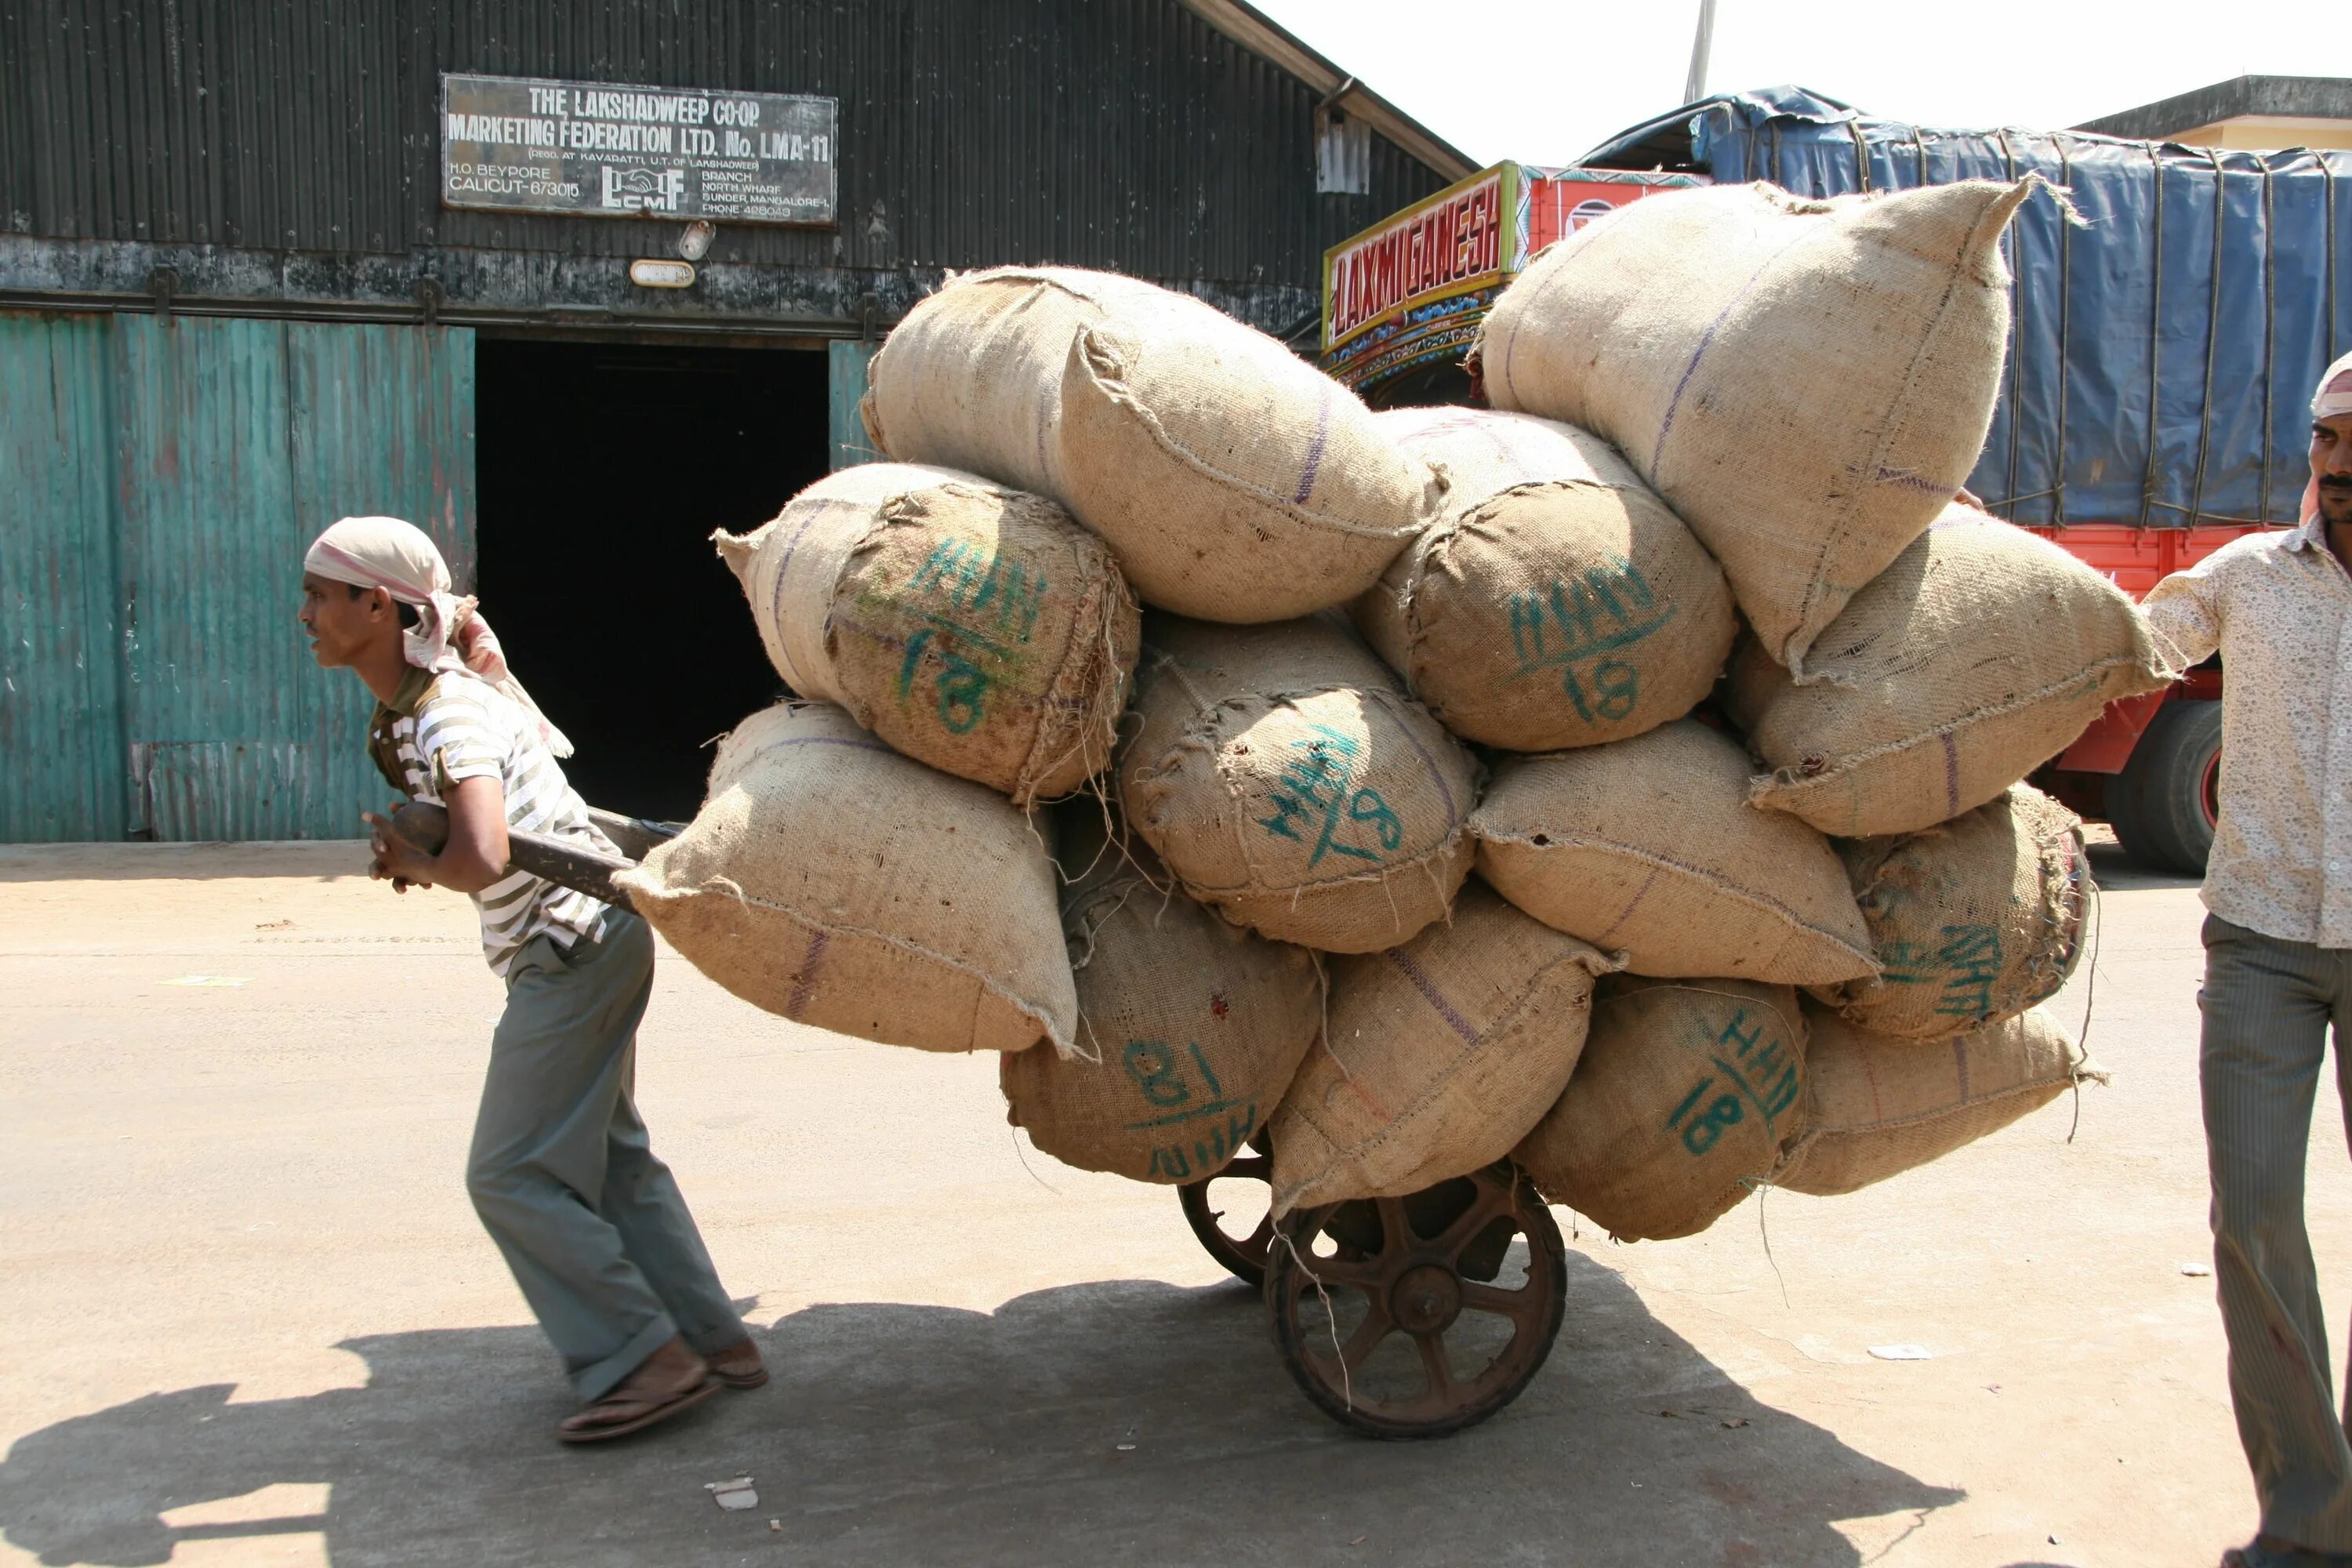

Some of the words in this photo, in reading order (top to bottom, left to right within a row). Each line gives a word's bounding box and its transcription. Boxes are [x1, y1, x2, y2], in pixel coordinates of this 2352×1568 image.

[529, 87, 568, 116] THE
[575, 90, 709, 125] LAKSHADWEEP
[448, 113, 555, 147] MARKETING
[559, 121, 672, 154] FEDERATION
[681, 128, 718, 156] LTD.
[724, 130, 755, 158] No.
[760, 132, 829, 162] LMA-11
[562, 151, 575, 161] AT
[650, 157, 671, 166] U.T.
[673, 158, 687, 167] OF
[690, 158, 760, 172] LAKSHADWEEP)
[449, 163, 474, 176] H.O.
[477, 164, 550, 180] BEYPORE
[702, 171, 753, 182] BRANCH
[702, 182, 739, 192] NORTH
[742, 184, 781, 194] WHARF
